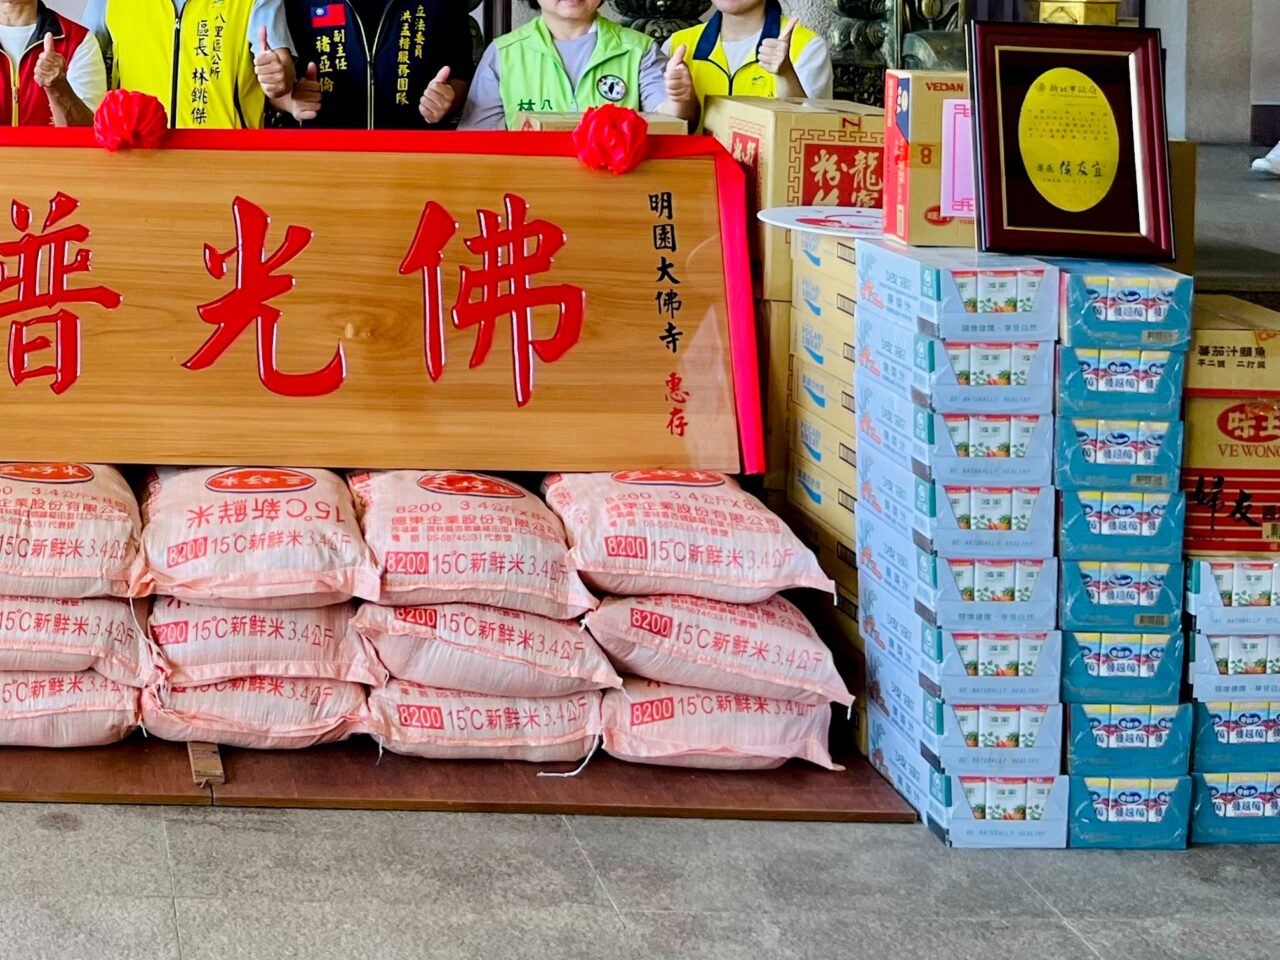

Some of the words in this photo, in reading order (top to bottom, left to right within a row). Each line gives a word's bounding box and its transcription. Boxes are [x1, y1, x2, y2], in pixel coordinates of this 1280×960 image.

[193, 19, 209, 58] 區長
[209, 13, 227, 79] 八里區公所
[414, 5, 426, 59] 立法委員
[333, 29, 348, 70] 副主任
[396, 10, 412, 105] 洪孟楷服務團隊
[926, 82, 964, 92] VEDAN
[648, 191, 685, 354] 明園大佛寺
[664, 371, 690, 438] 惠存
[1218, 444, 1239, 457] VE
[168, 538, 207, 567] 8200
[606, 537, 647, 557] 8200
[387, 553, 428, 573] 8200
[632, 609, 670, 636] 8200
[399, 706, 442, 728] 8200
[632, 699, 673, 725] 8200
